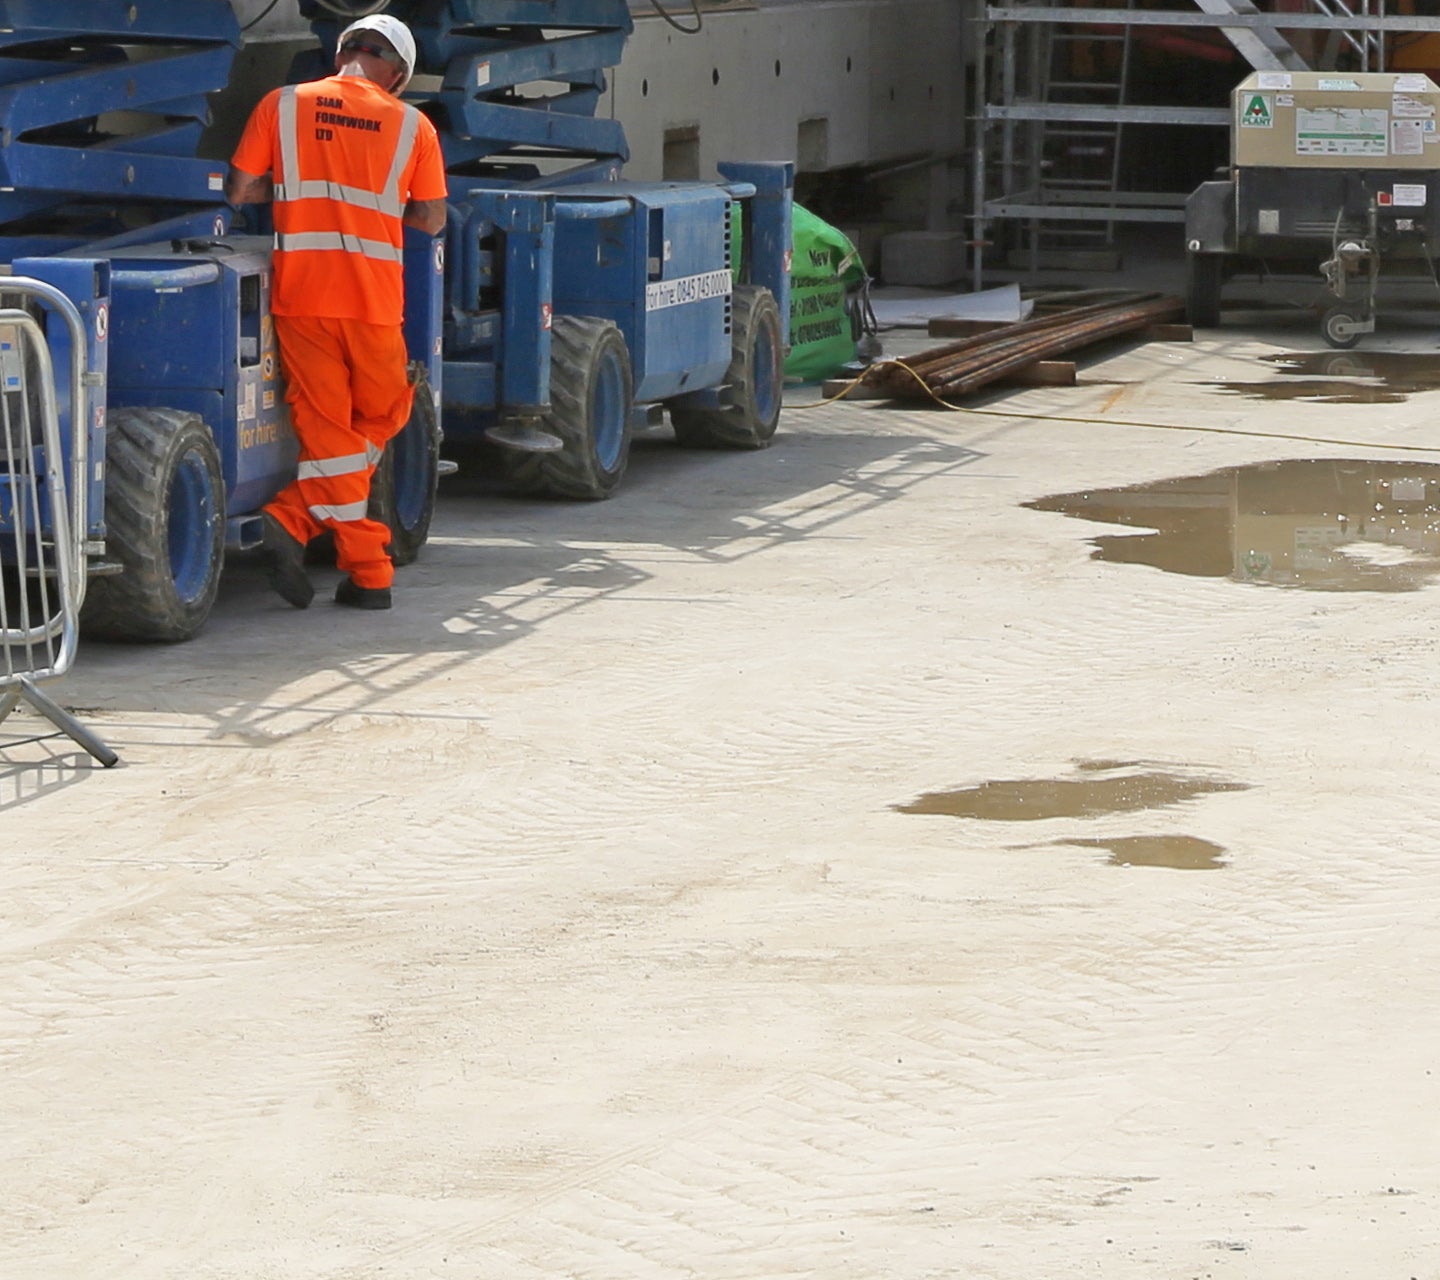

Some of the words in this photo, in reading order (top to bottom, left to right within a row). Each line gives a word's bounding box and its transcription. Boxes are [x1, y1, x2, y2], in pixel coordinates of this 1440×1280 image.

[315, 111, 382, 133] FORMWORK
[1242, 117, 1272, 127] PLANT
[315, 127, 333, 141] LTD
